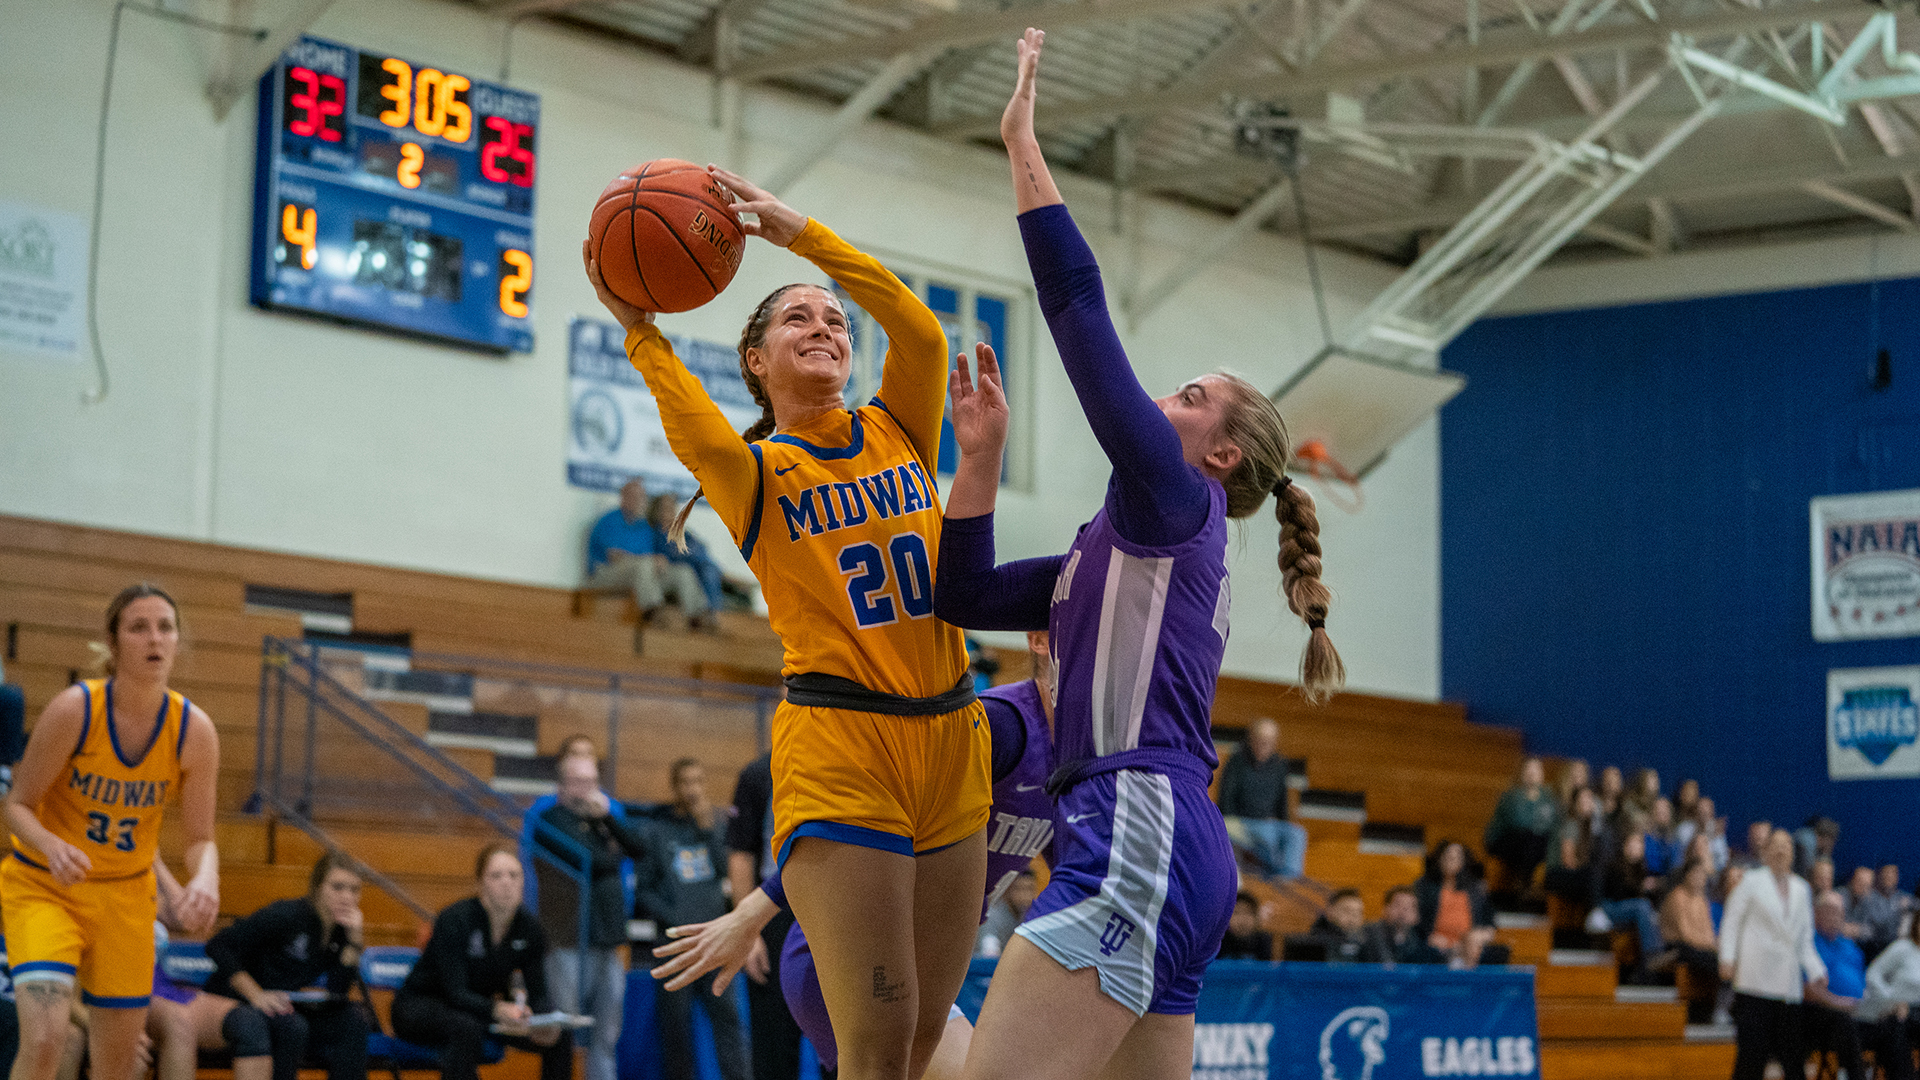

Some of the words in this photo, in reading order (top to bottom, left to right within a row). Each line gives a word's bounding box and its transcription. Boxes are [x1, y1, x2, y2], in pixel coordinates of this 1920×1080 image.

[289, 66, 346, 143] 32
[396, 141, 425, 190] 2
[480, 115, 536, 188] 25
[281, 203, 318, 271] 4
[499, 248, 533, 319] 2
[777, 460, 933, 544] MIDWAY
[1826, 519, 1920, 567] NAIA
[836, 531, 934, 630] 20
[69, 768, 171, 808] MIDWAY
[86, 810, 140, 853] 33
[1420, 1035, 1536, 1078] EAGLES
